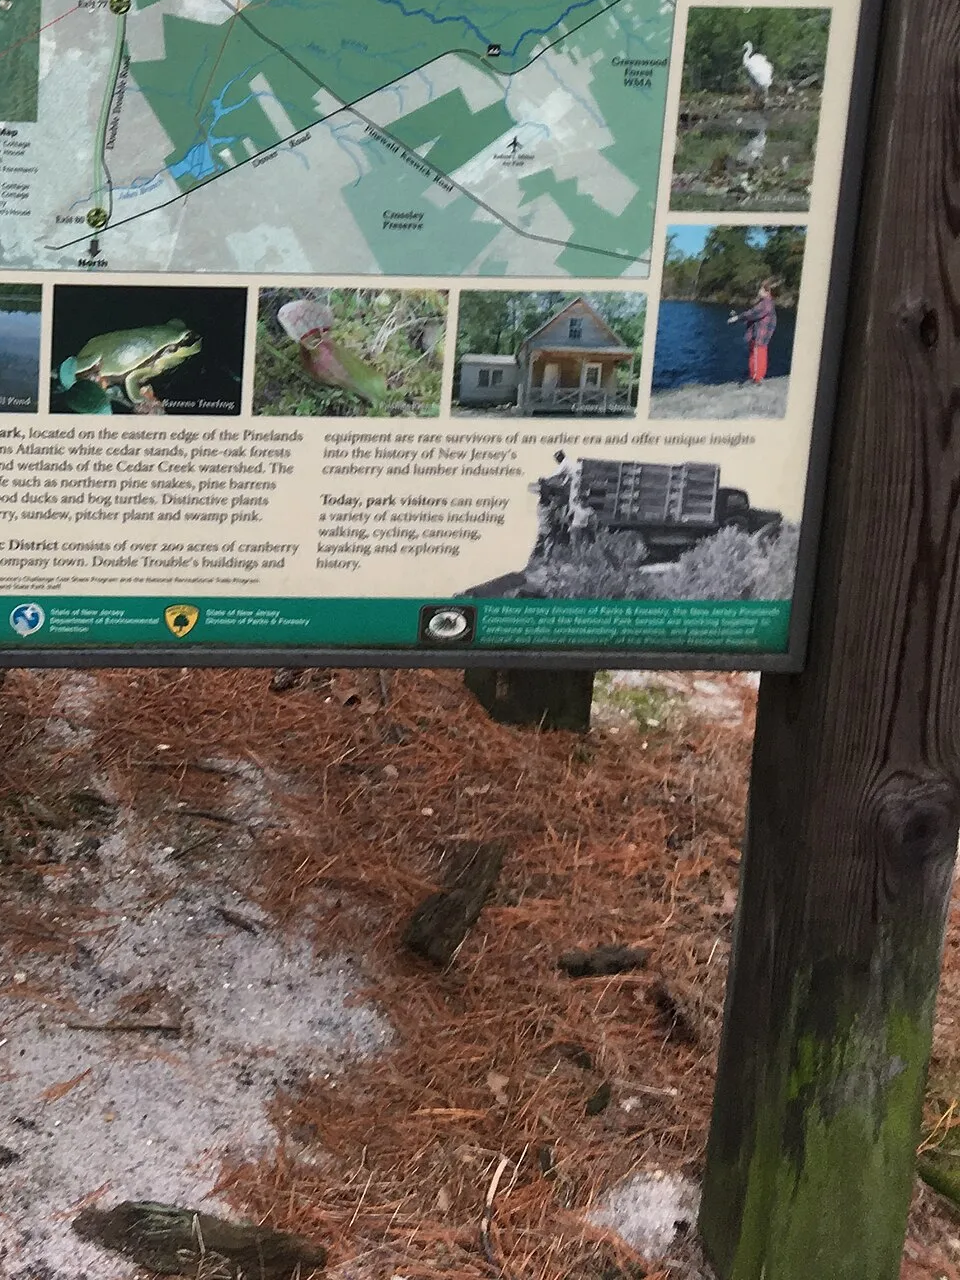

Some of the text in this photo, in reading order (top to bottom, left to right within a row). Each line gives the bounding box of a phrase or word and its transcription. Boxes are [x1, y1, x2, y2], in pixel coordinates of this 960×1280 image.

[611, 56, 668, 67] Greenwood
[624, 68, 653, 77] Forest
[433, 175, 454, 193] Road
[78, 258, 108, 268] North
[7, 395, 31, 406] Pond
[28, 427, 76, 439] located
[77, 431, 96, 439] on
[97, 427, 119, 440] the
[120, 430, 167, 440] eastern
[169, 428, 200, 443] edge
[201, 429, 218, 441] of
[218, 430, 240, 441] the
[242, 429, 304, 442] Pinelands
[15, 443, 66, 455] Atlantic
[67, 444, 104, 456] white
[105, 444, 142, 456] cedar
[143, 445, 188, 458] stands,
[190, 446, 247, 459] pine-oak
[249, 445, 292, 458] forests
[16, 460, 74, 471] wetlands
[75, 460, 92, 472] of
[92, 460, 114, 472] the
[115, 461, 156, 472] Cedar
[157, 459, 196, 473] Creek
[198, 462, 267, 474] watershed.
[268, 463, 295, 474] The
[319, 494, 511, 510] Today, park visitors can enjoy
[317, 525, 482, 542] walking, cycling, canoeing,
[315, 557, 361, 572] history.
